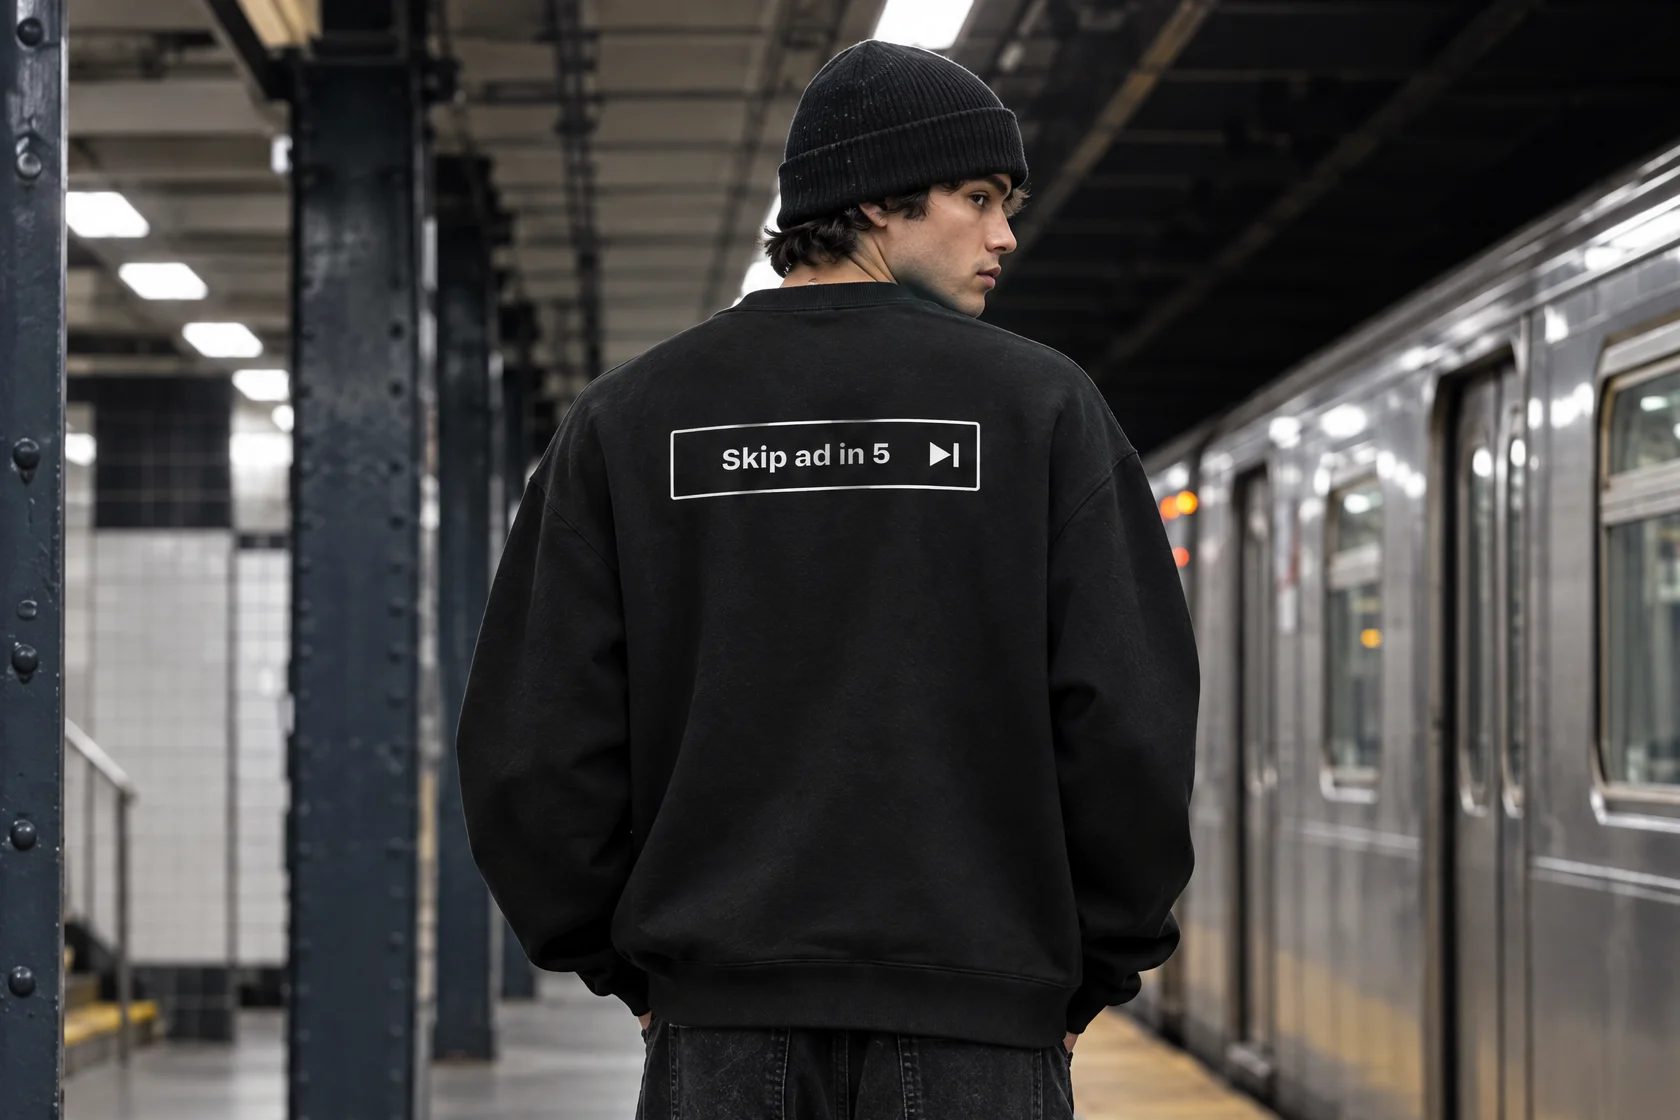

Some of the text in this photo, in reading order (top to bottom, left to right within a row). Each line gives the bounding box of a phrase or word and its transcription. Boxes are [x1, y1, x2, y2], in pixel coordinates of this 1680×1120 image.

[722, 442, 891, 473] Skip ad in 5
